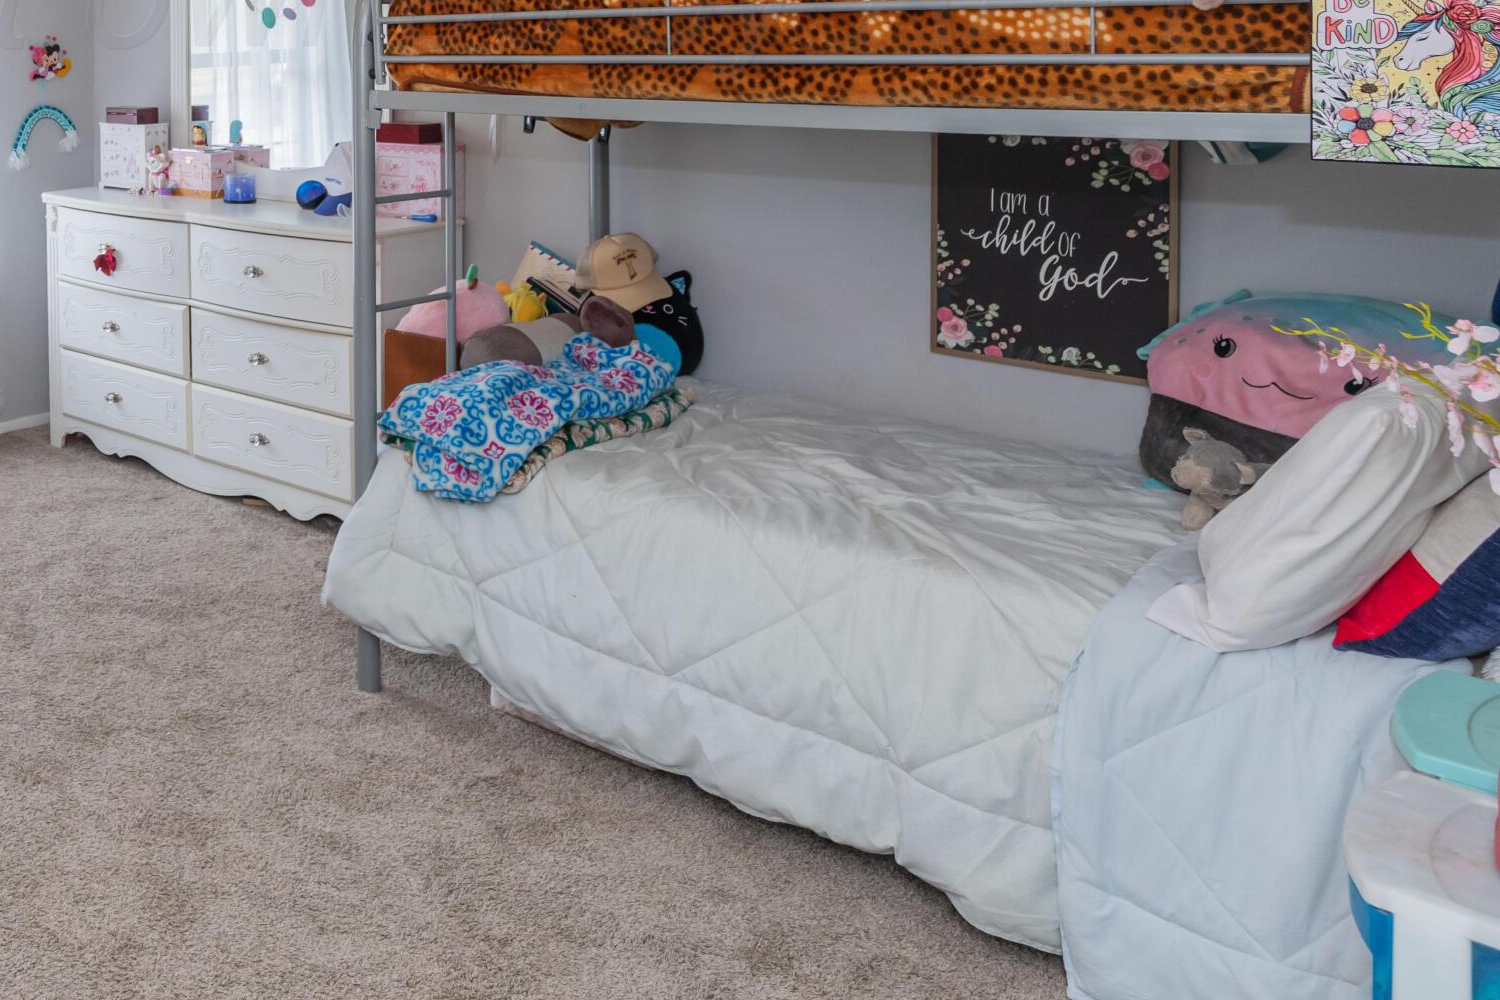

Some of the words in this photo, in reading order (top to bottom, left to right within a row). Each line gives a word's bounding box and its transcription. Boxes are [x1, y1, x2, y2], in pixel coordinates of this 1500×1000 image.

[990, 187, 995, 213] I
[1000, 191, 1028, 215] am
[1038, 194, 1050, 217] a
[960, 214, 1056, 257] child
[1038, 251, 1148, 301] God
